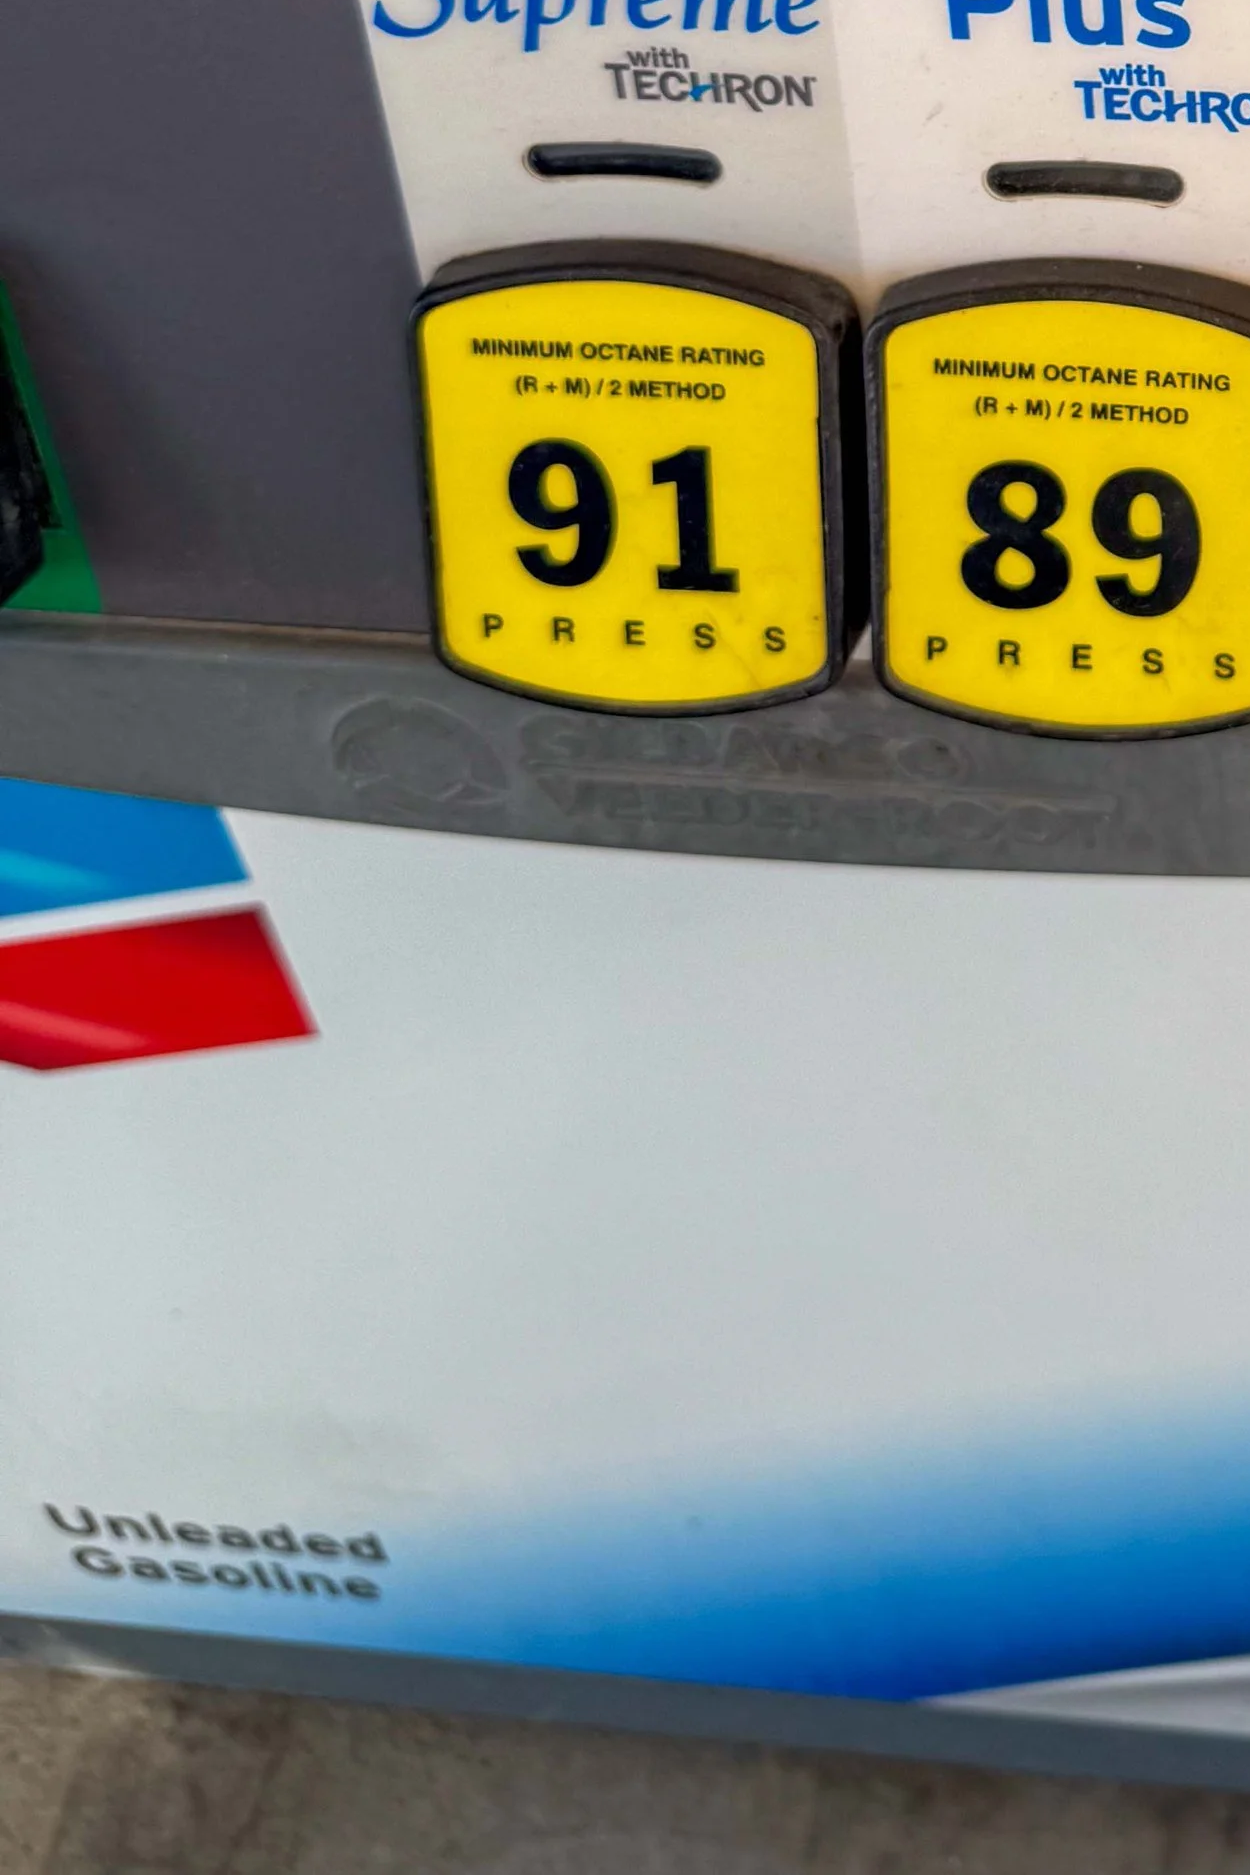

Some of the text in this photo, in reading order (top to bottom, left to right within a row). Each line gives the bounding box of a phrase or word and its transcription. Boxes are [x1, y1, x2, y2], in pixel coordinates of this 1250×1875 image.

[626, 46, 689, 69] with
[1098, 62, 1167, 87] with
[471, 338, 765, 367] MINIMUM OCTANE RATING
[628, 380, 726, 401] METHOD
[933, 358, 1230, 392] MINIMUM OCTANE RATING
[1090, 402, 1189, 425] METHOD
[507, 438, 739, 593] 91
[960, 460, 1201, 618] 89
[43, 1502, 390, 1563] Unleaded
[73, 1545, 382, 1601] Gasoline
